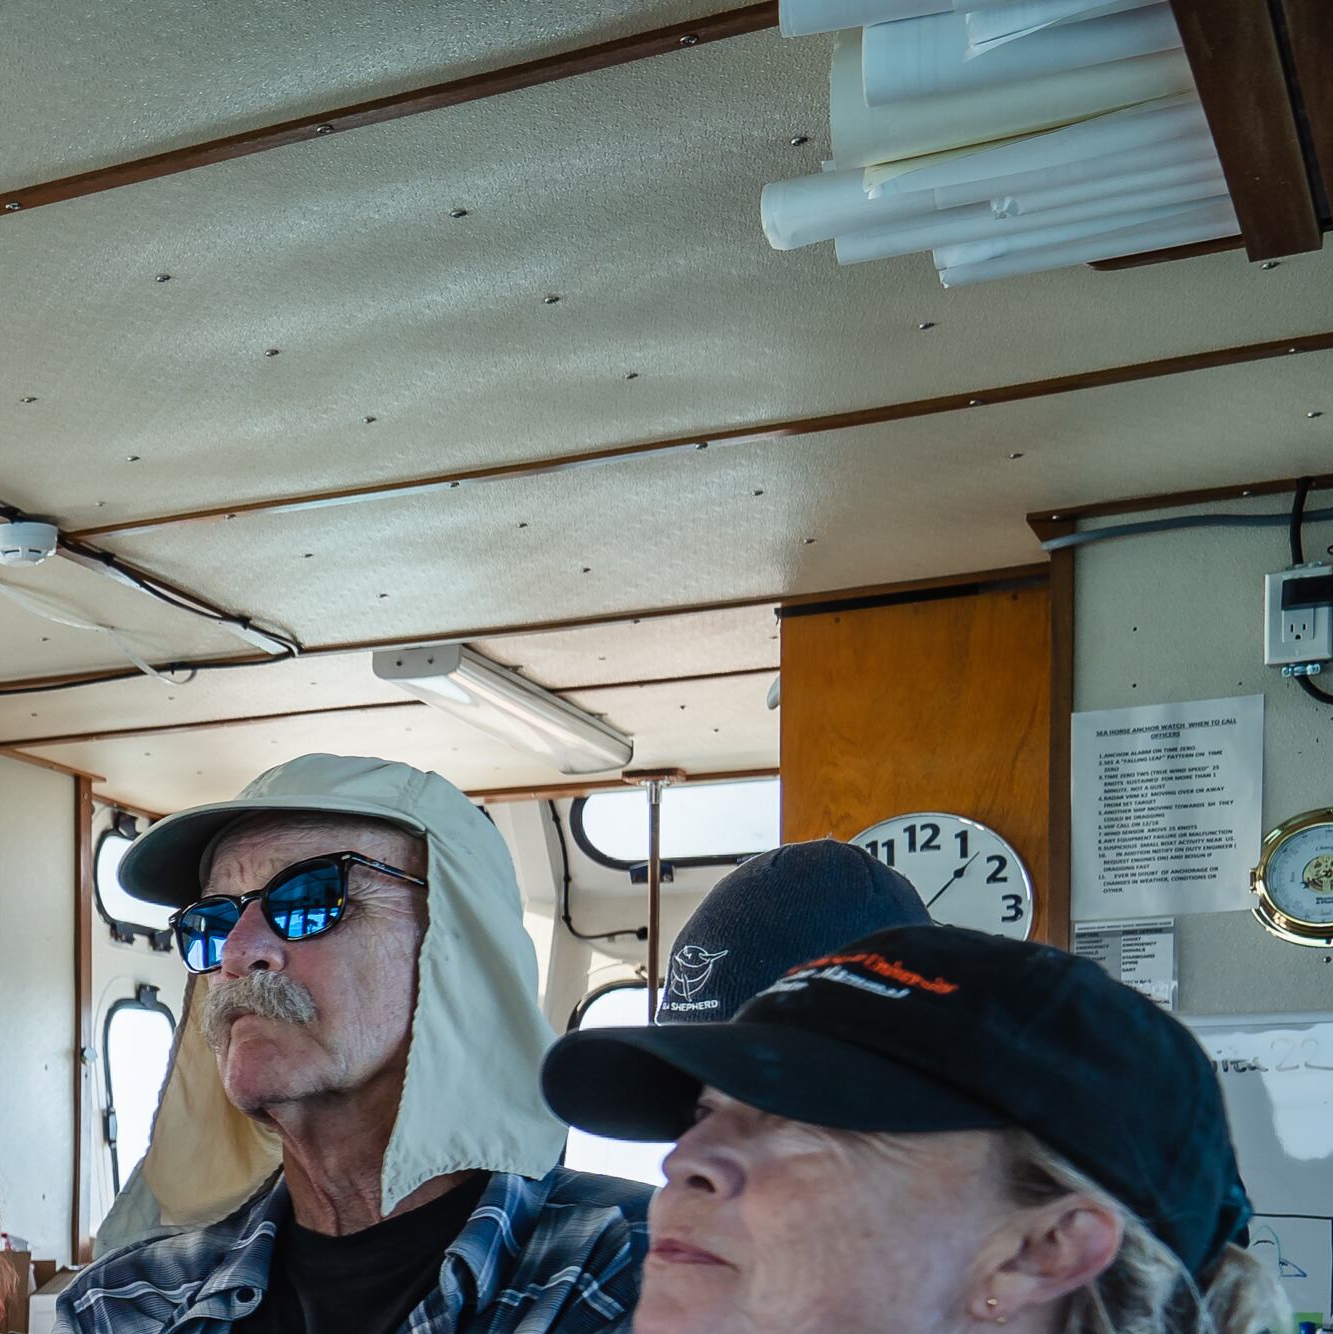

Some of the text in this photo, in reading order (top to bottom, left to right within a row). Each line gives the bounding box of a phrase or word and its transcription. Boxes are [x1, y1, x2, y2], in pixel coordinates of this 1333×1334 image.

[1133, 726, 1160, 734] ANCHOR
[1161, 723, 1186, 731] WATCH
[903, 823, 941, 853] 12
[955, 830, 968, 858] 1
[986, 855, 1008, 884] 2
[1001, 894, 1024, 922] 3
[671, 1000, 718, 1012] SHEPHERD
